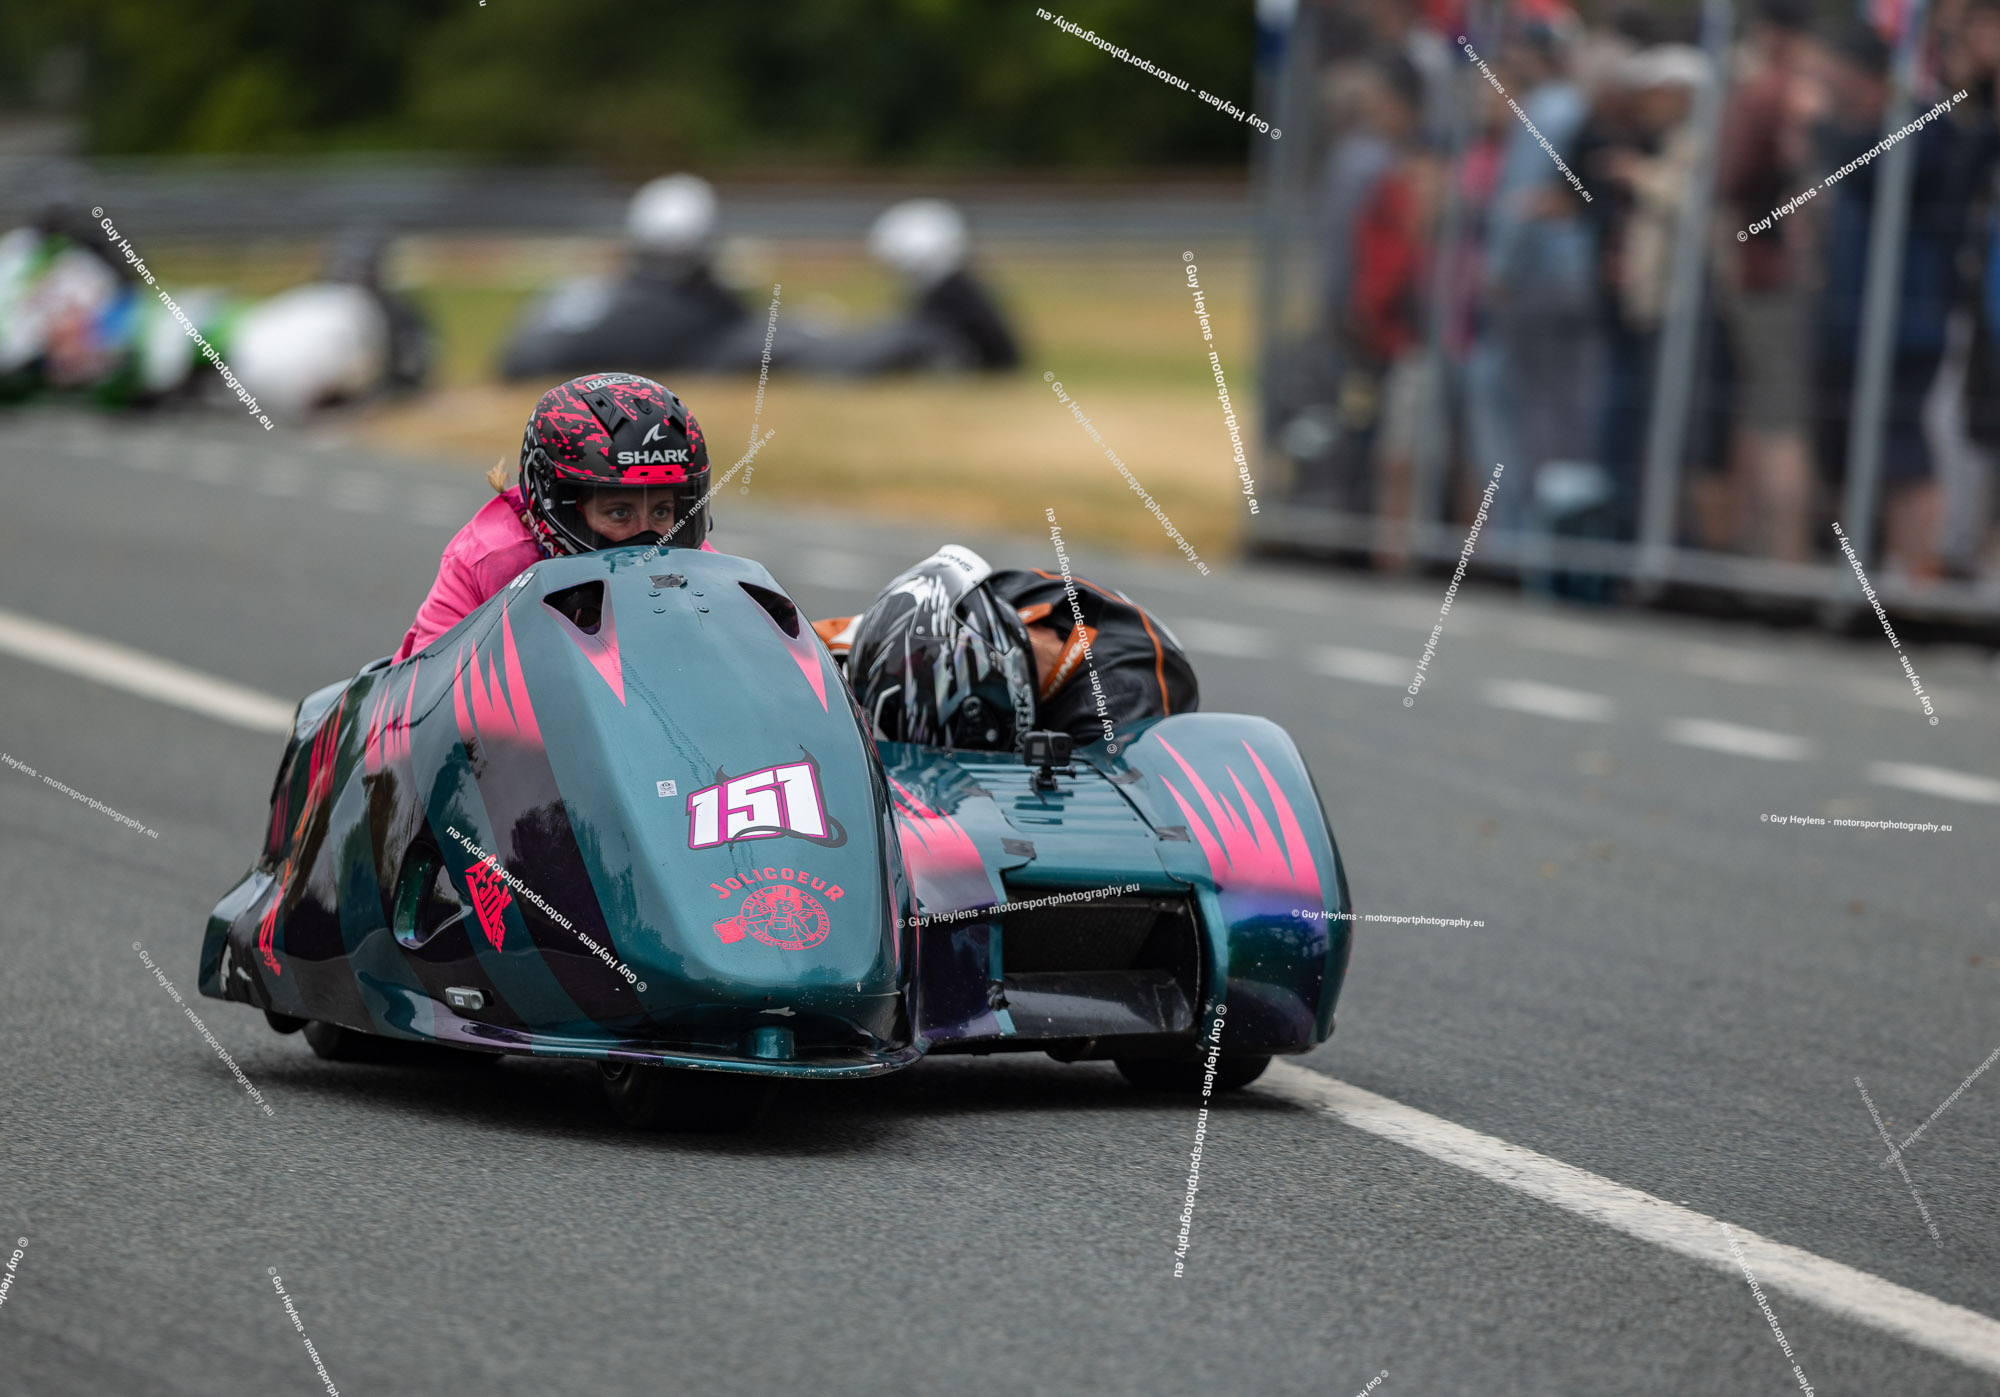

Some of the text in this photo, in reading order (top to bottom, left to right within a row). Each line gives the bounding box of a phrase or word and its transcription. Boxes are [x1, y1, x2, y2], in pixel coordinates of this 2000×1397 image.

[617, 449, 689, 465] SHARK
[688, 763, 827, 848] 151
[710, 867, 845, 902] JOLICOEUR
